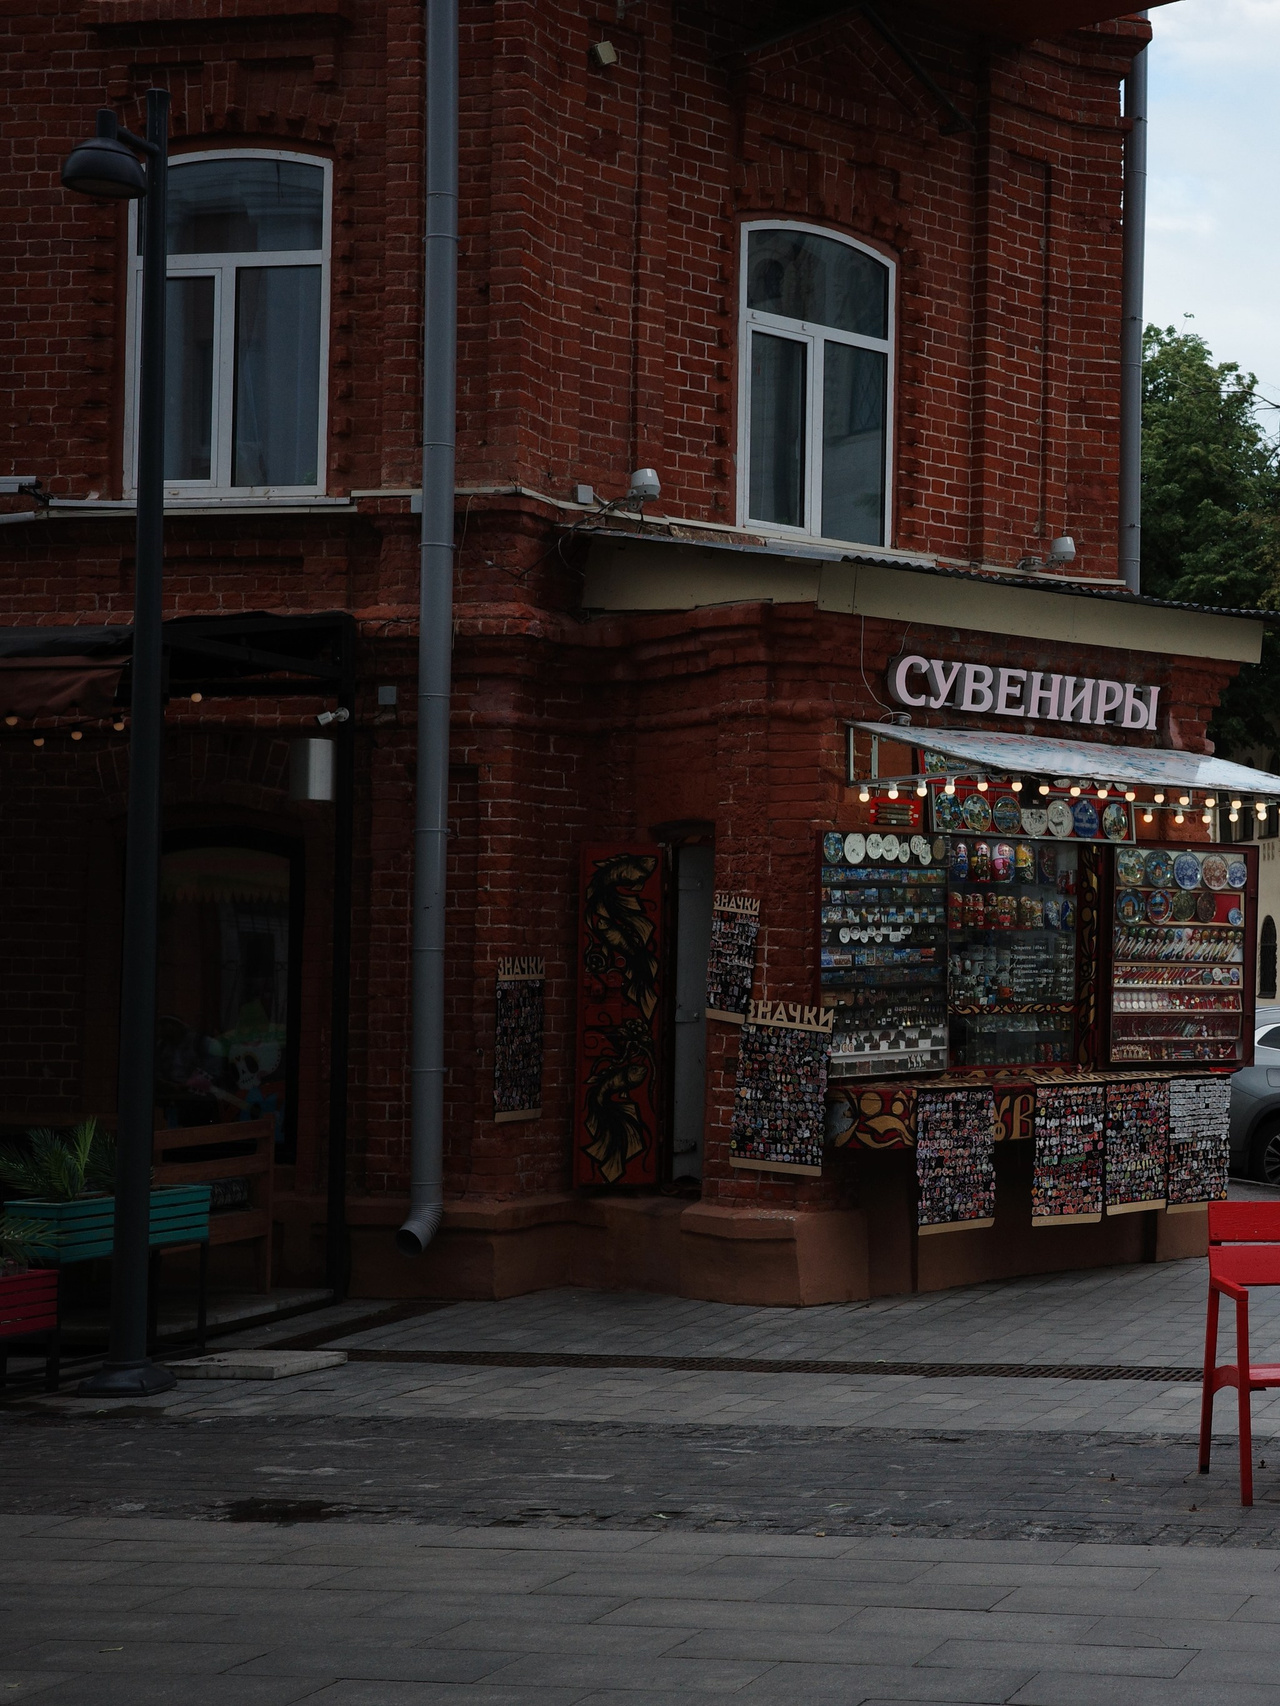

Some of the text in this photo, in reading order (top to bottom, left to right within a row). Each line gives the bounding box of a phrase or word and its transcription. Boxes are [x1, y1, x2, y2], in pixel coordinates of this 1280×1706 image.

[894, 655, 1161, 730] СУВЕНИРЫ
[714, 893, 761, 913] ЗНАЧКИ
[498, 956, 546, 976] ЗНАЧКИ
[746, 999, 834, 1028] ЗНАЧКИ
